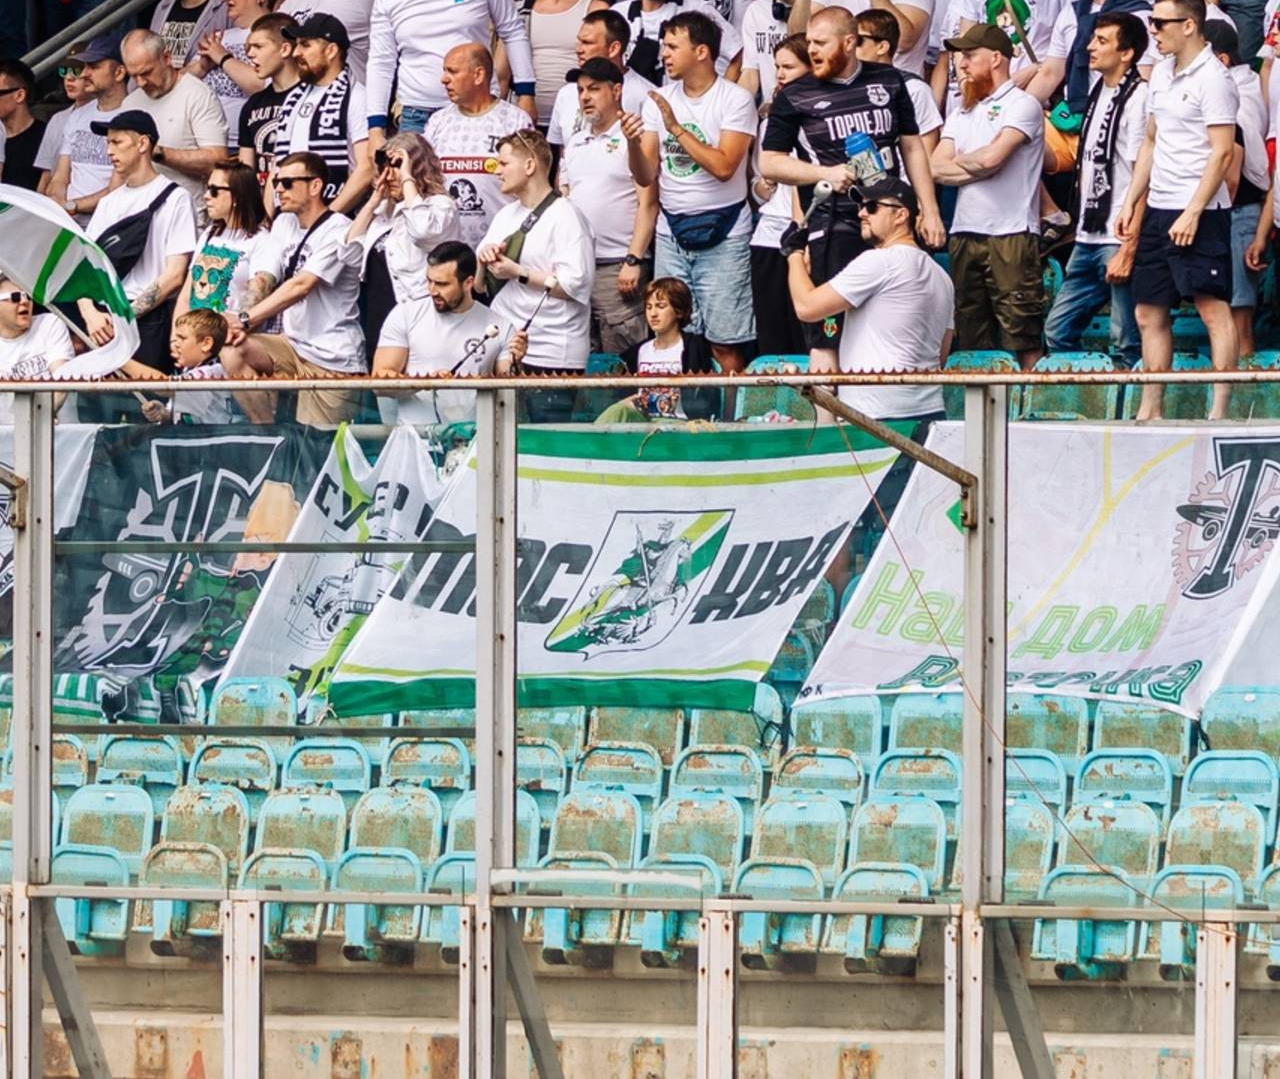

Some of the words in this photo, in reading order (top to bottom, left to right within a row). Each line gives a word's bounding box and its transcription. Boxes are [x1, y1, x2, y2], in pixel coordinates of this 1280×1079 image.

[824, 110, 893, 141] ТОРПЕДО
[440, 159, 483, 173] TENNISI
[690, 521, 850, 625] КВА
[1012, 602, 1168, 661] дом
